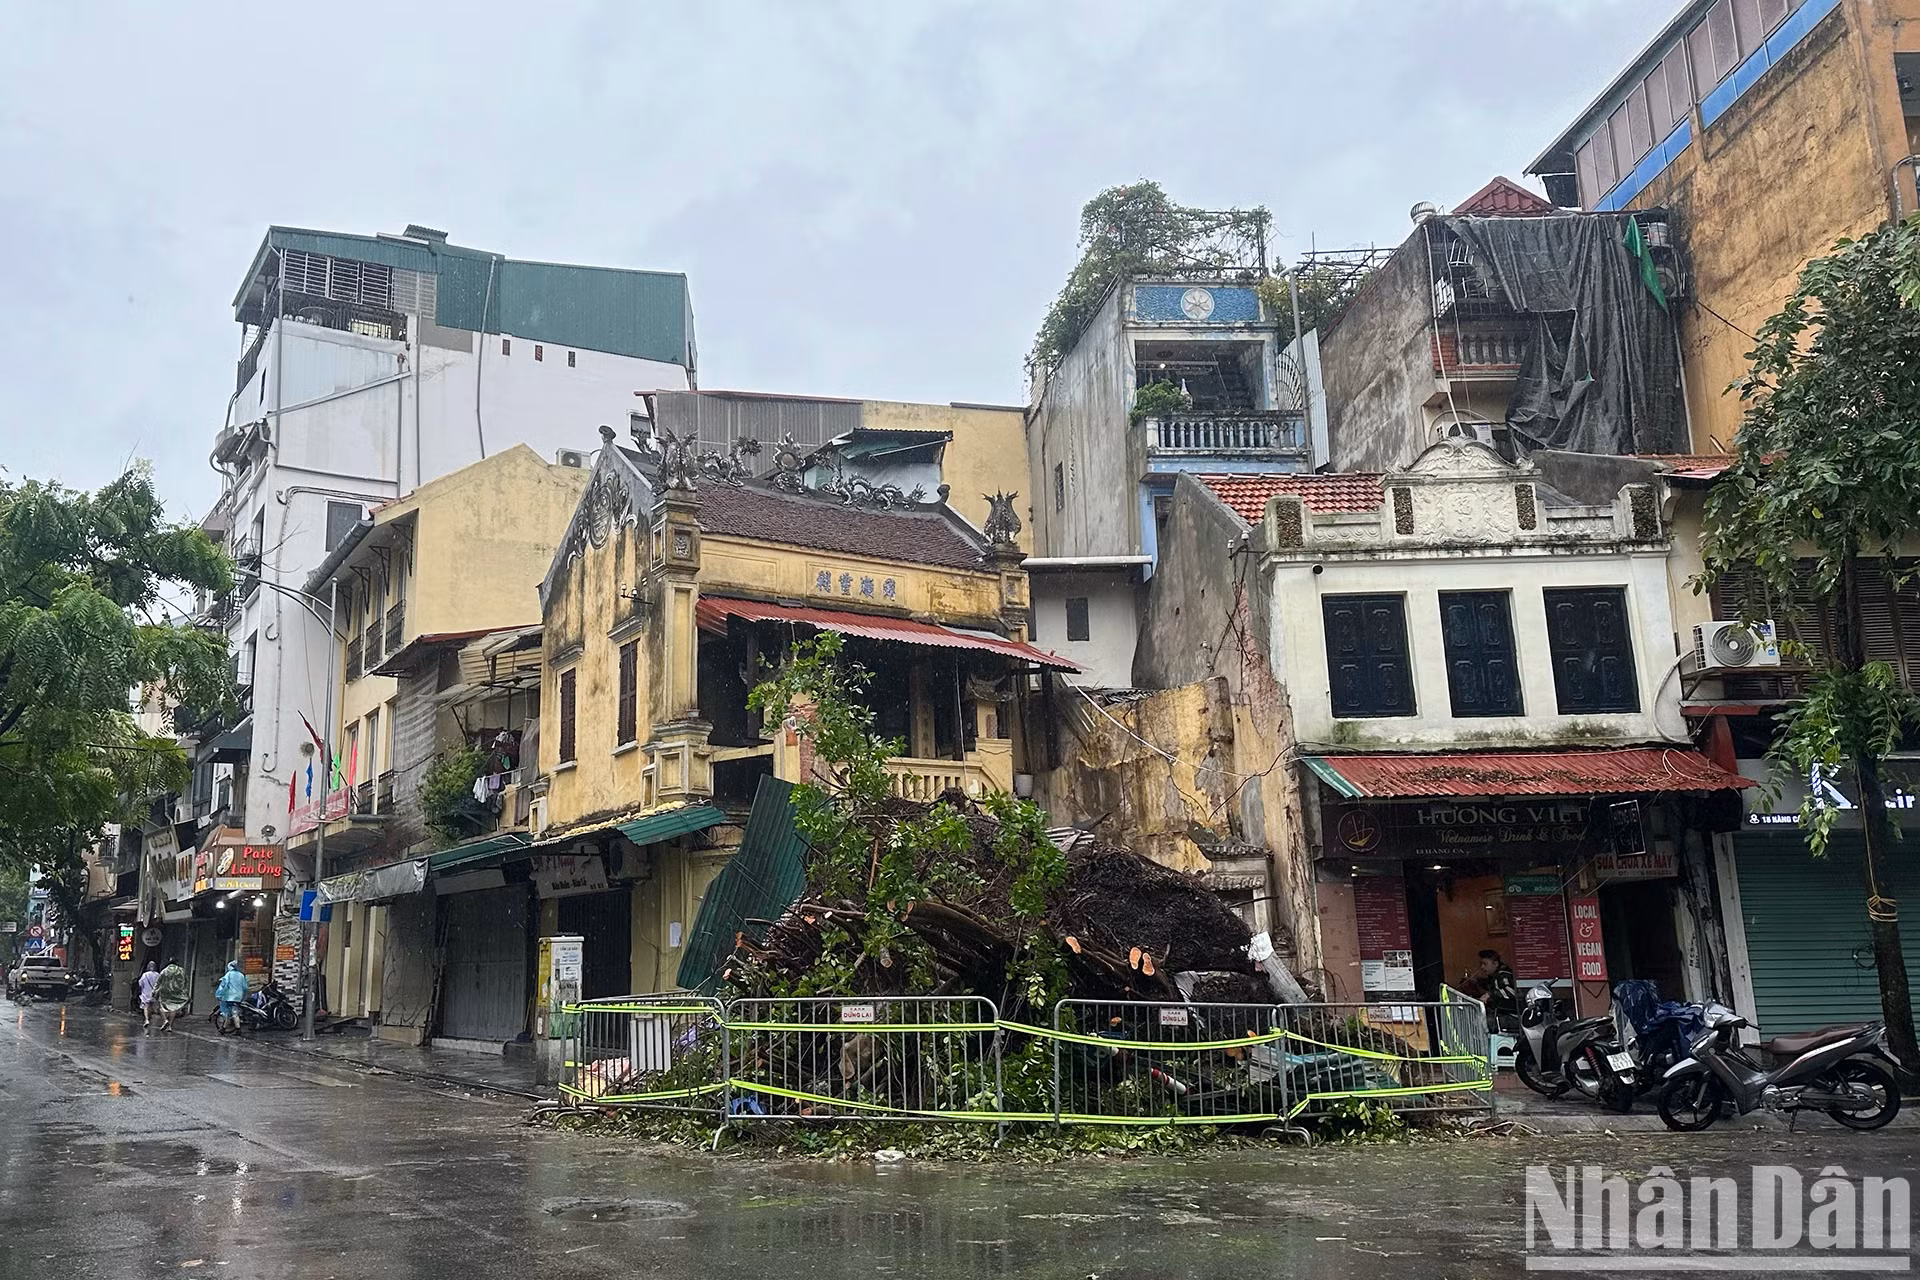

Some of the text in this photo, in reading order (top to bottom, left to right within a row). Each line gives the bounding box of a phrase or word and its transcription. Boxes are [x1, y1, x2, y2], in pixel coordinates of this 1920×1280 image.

[1436, 829, 1495, 844] Vietnamese
[243, 846, 274, 859] Pate
[257, 860, 282, 878] Ông
[1574, 905, 1598, 919] LOCAL
[1579, 922, 1595, 938] &
[1577, 942, 1602, 956] VEGAN
[1582, 961, 1602, 976] FOOD
